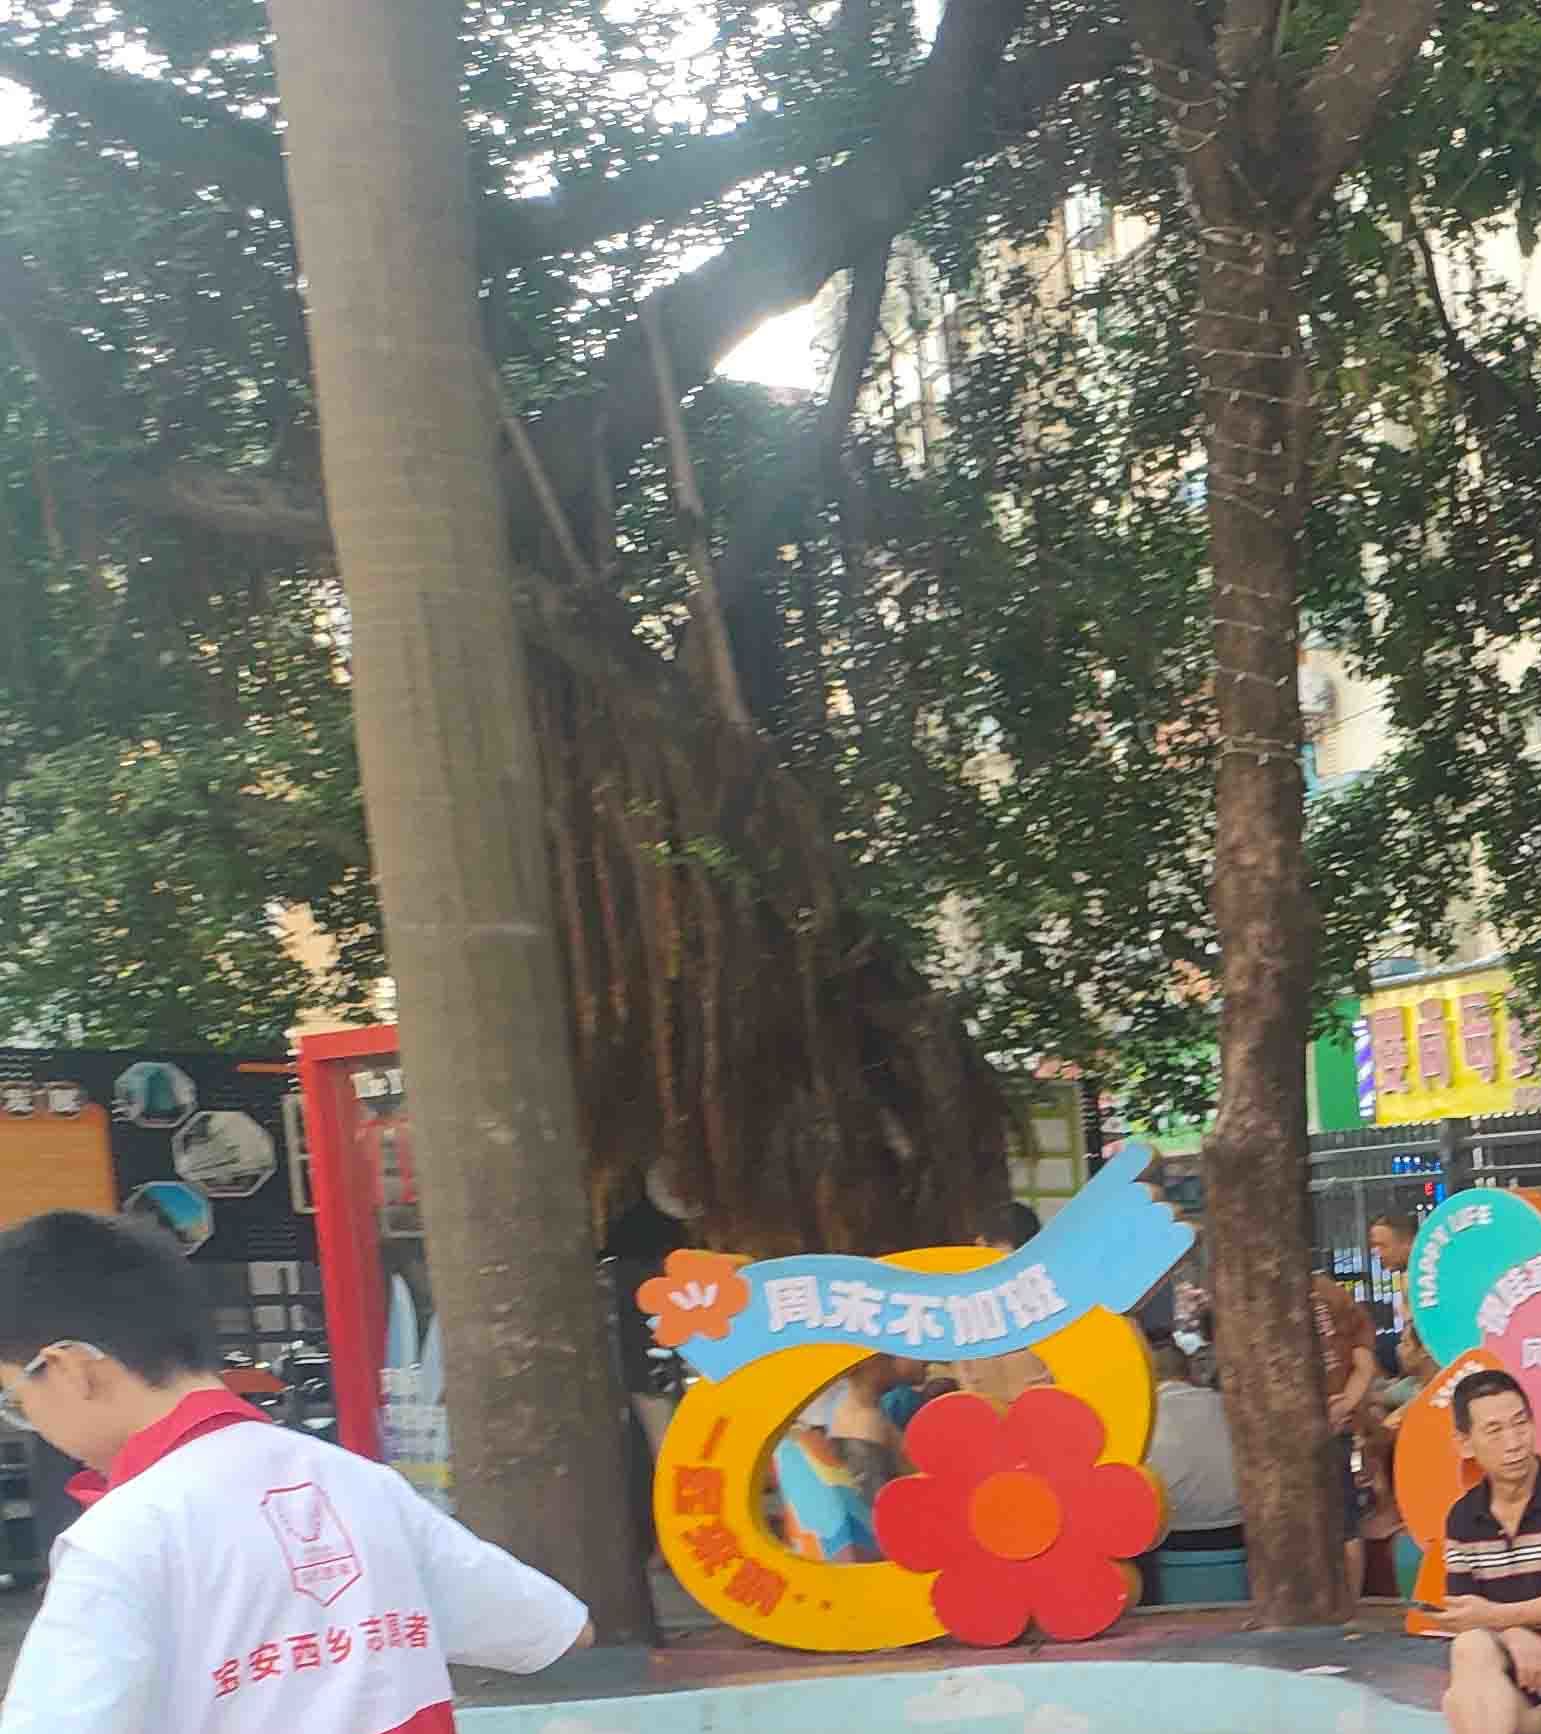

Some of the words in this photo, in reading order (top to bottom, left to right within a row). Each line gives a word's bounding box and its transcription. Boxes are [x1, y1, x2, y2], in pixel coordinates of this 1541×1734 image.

[764, 1262, 1069, 1347] 周末不加班
